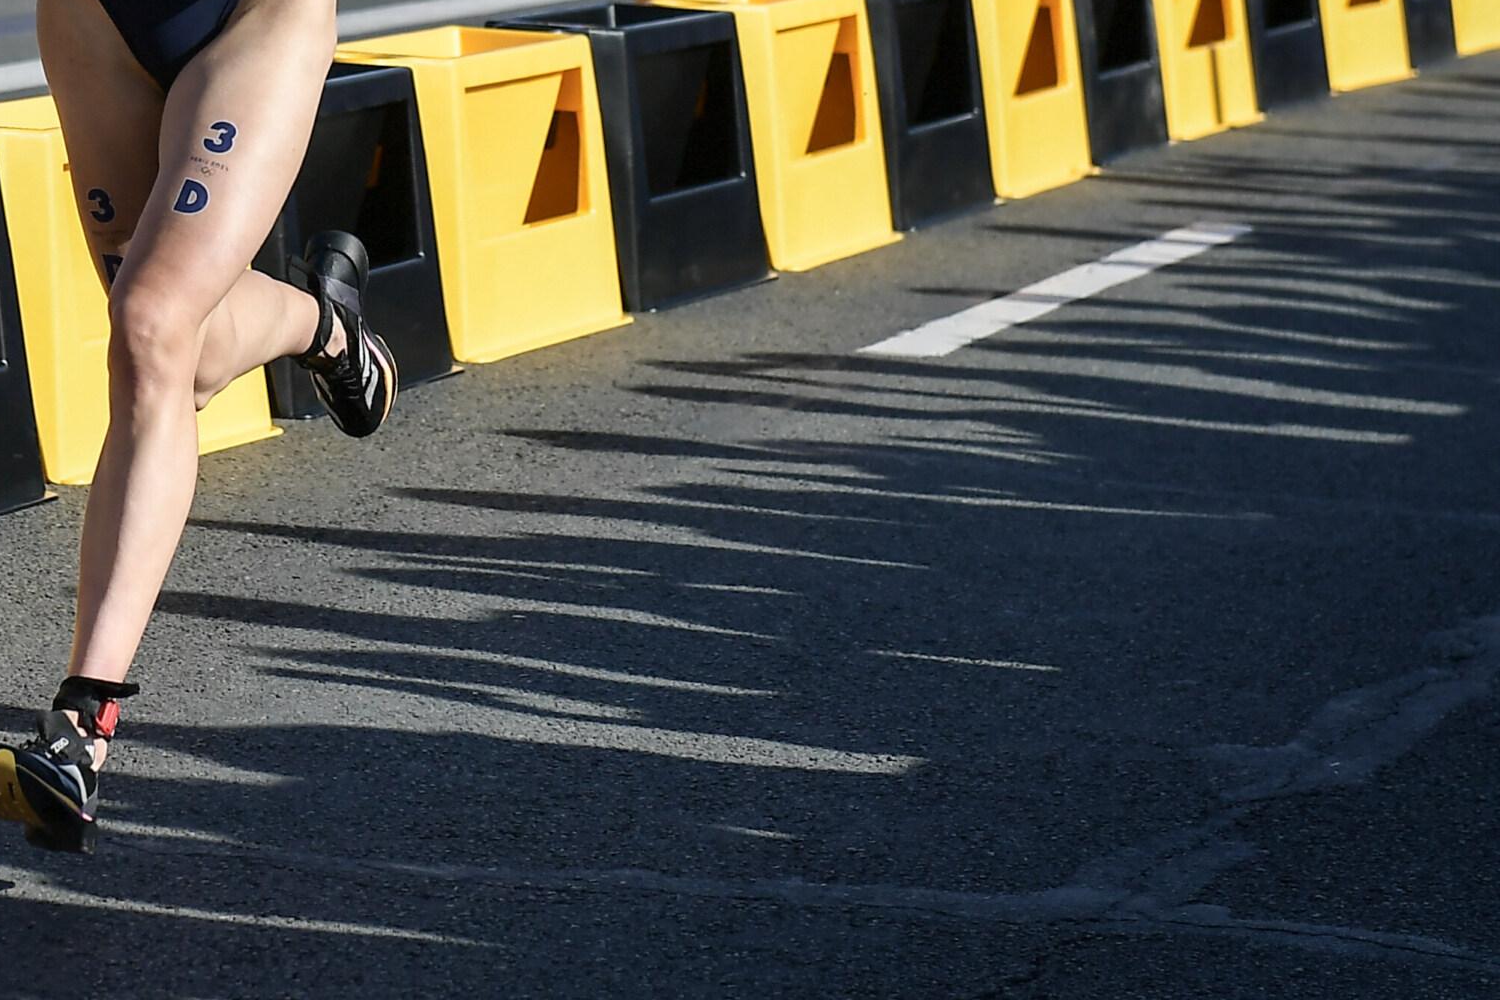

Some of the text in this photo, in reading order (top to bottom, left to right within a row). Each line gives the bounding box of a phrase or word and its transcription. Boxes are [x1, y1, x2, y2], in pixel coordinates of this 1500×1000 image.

[202, 120, 238, 154] 3
[87, 188, 116, 223] 3
[172, 177, 210, 215] D
